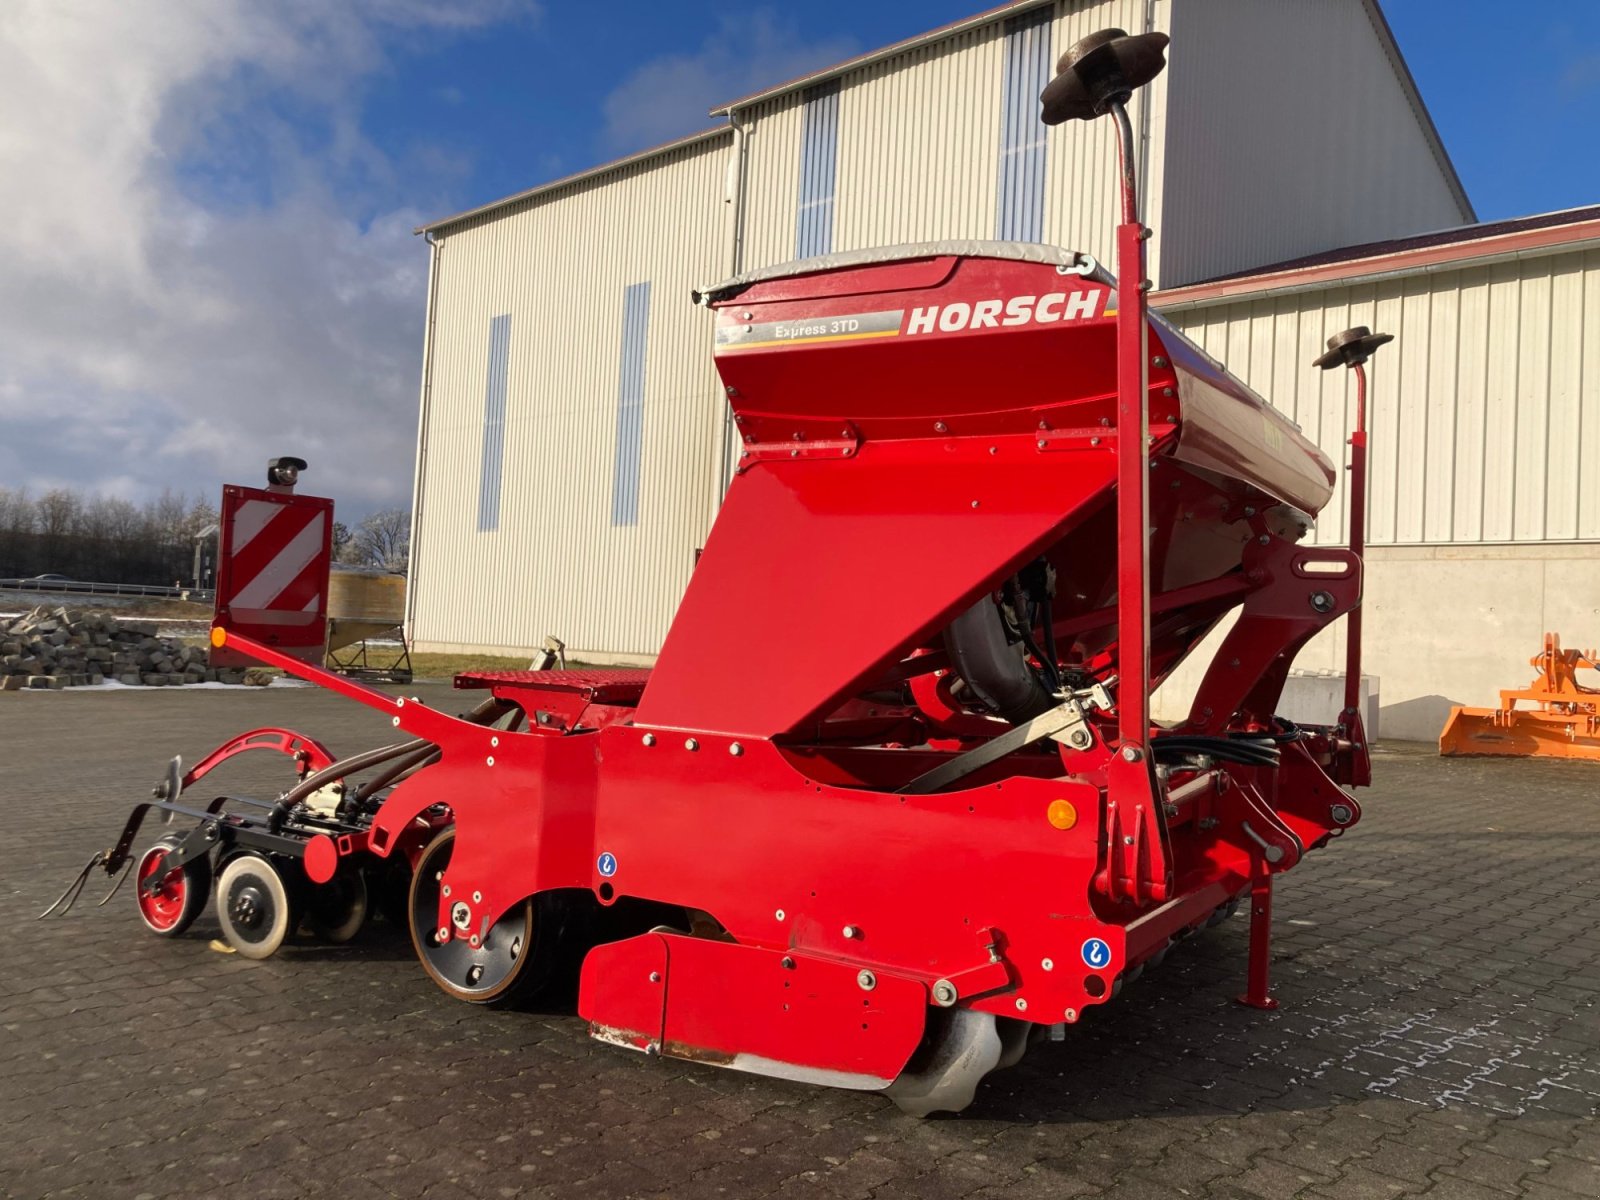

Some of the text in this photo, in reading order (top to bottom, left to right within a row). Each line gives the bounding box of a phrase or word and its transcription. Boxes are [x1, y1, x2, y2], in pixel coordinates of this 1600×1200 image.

[775, 319, 859, 339] Express 3TD
[906, 289, 1101, 336] HORSCH
